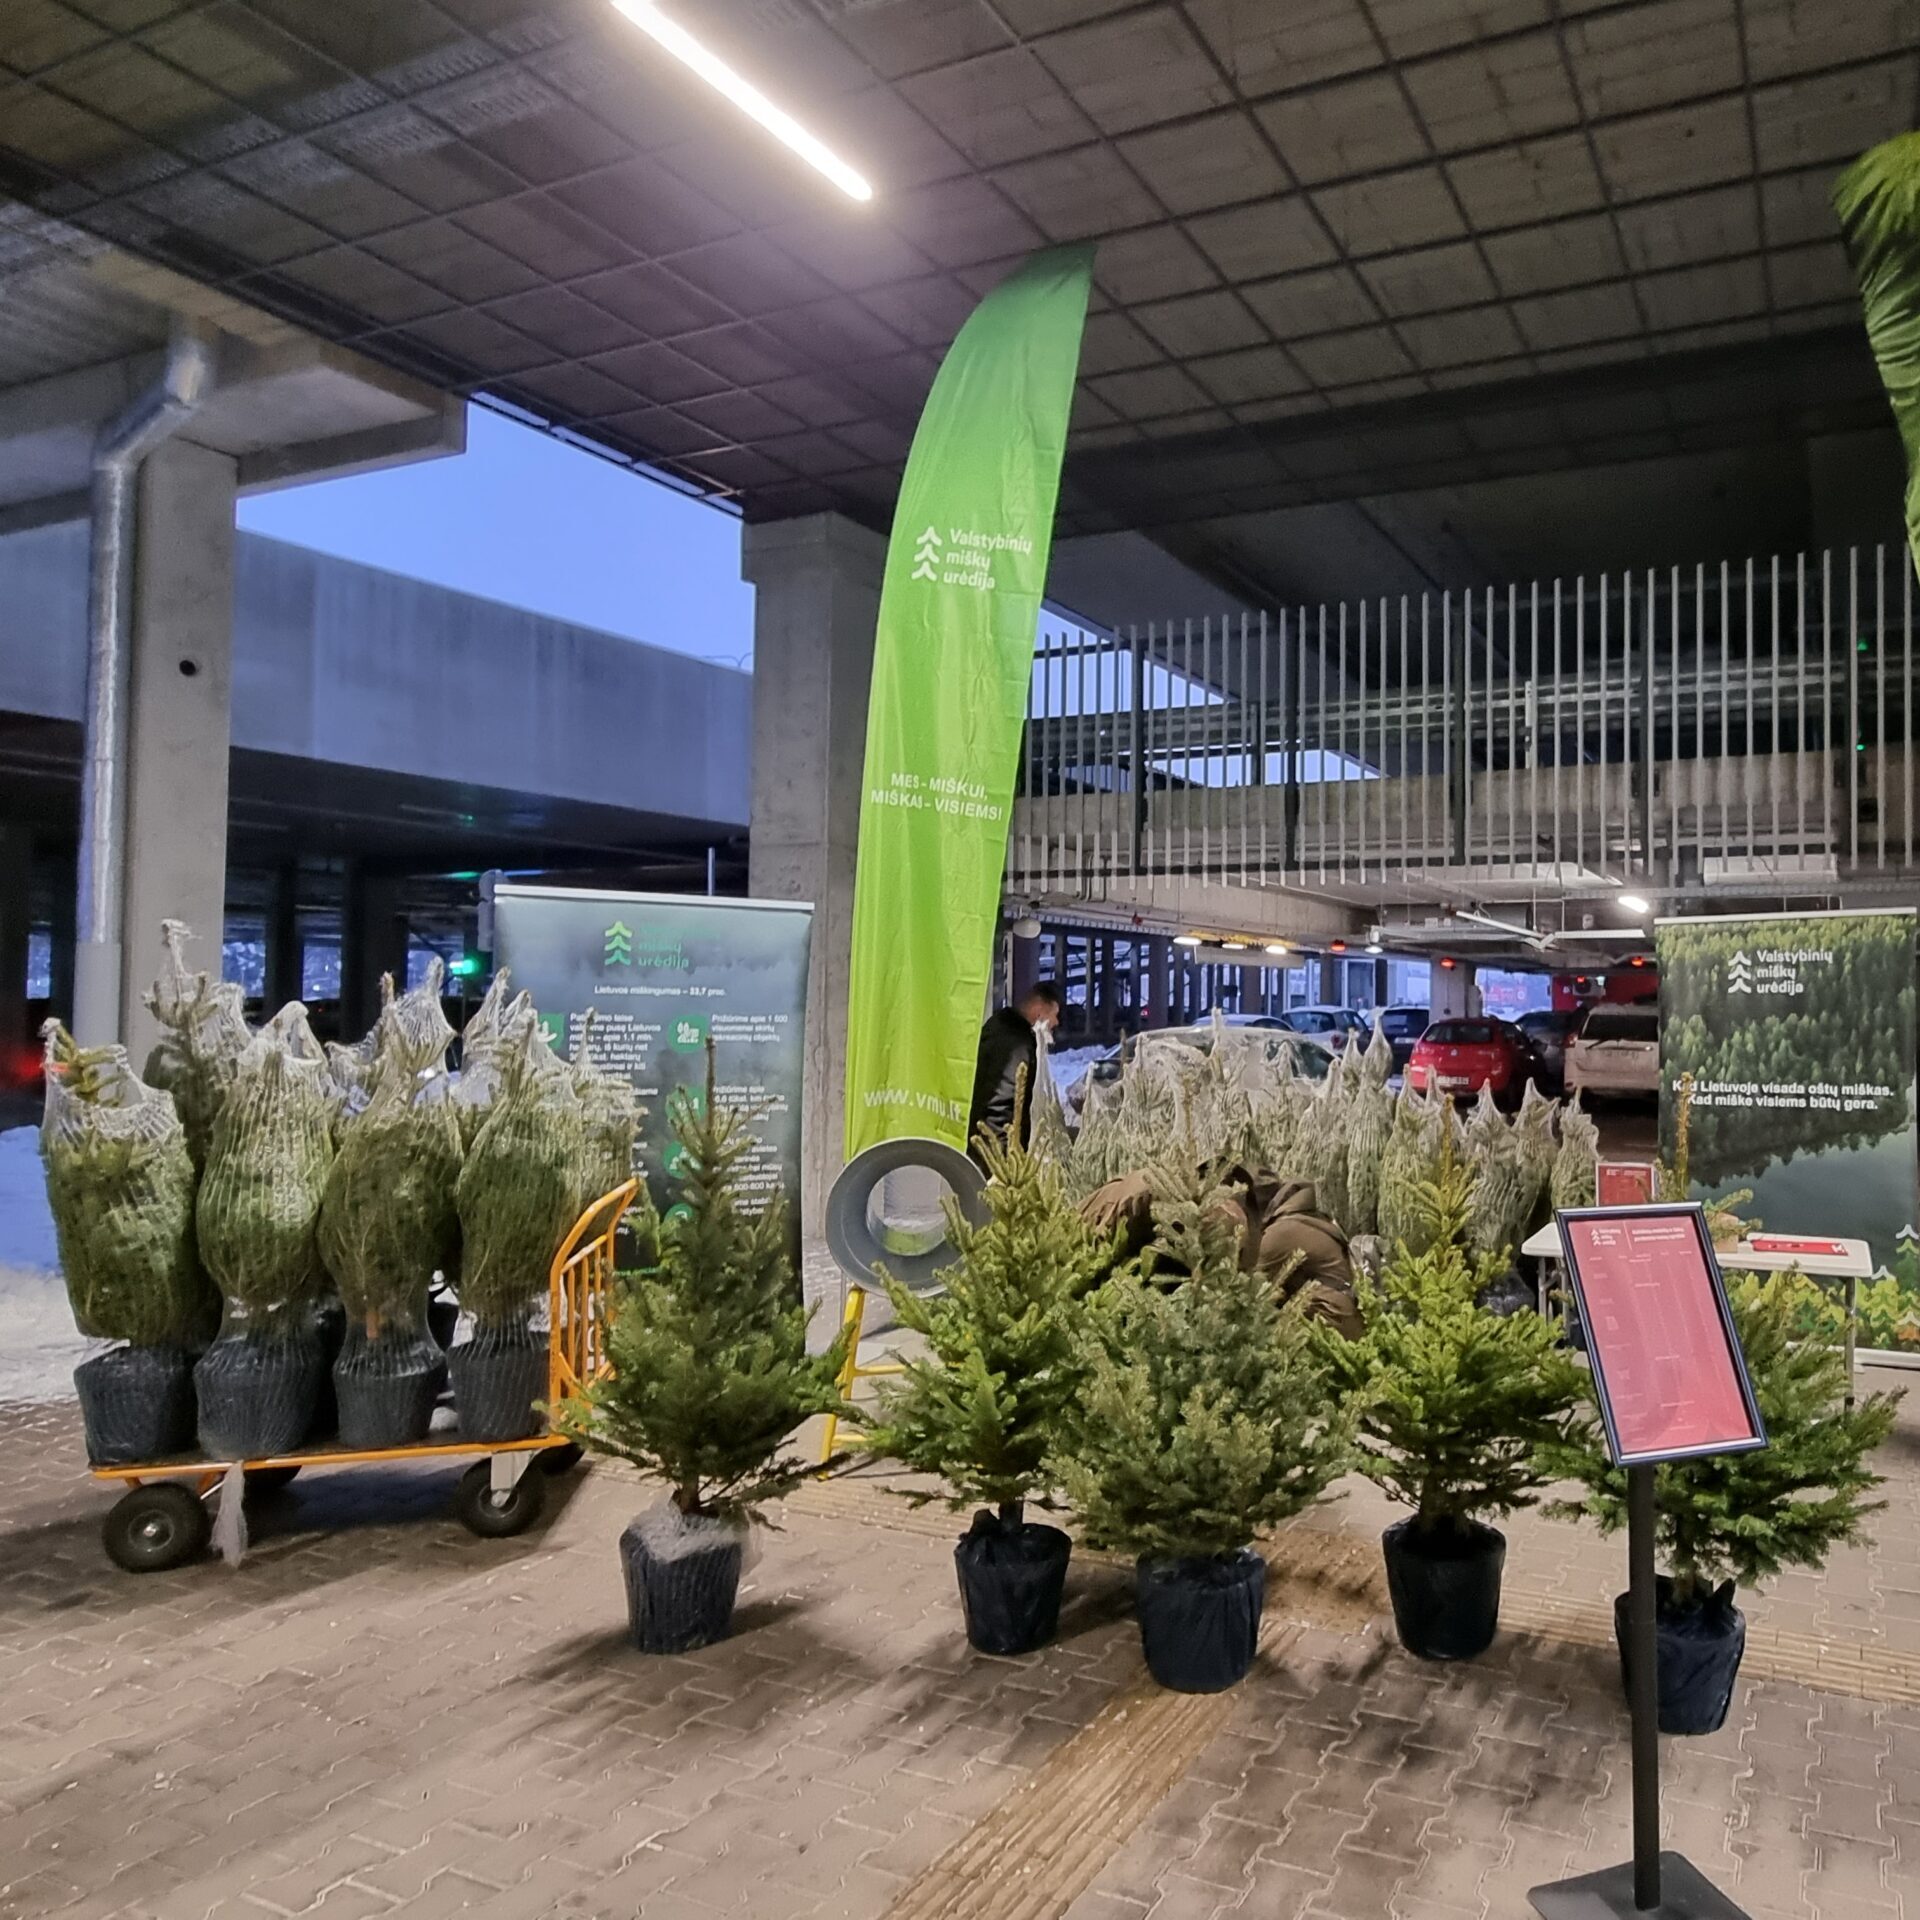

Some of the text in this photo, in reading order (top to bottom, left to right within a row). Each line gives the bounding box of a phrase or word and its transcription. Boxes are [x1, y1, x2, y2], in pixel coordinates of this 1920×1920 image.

[950, 528, 1032, 555] Valstybinių
[946, 550, 991, 571] miškų
[943, 569, 995, 591] urėdija
[891, 773, 919, 789] MES
[929, 777, 988, 801] MIŠKUI,
[1757, 948, 1833, 965] Valstybinių
[1757, 965, 1797, 980] miškų
[594, 985, 628, 995] Lietuvos
[1757, 981, 1804, 996] urėdija
[1672, 1080, 1894, 1098] Kd Lietuvoje visada oštų miškas.
[1715, 1095, 1753, 1107] miško
[1756, 1095, 1807, 1109] visiems
[1810, 1096, 1840, 1112] būtų
[1844, 1098, 1878, 1112] gera.
